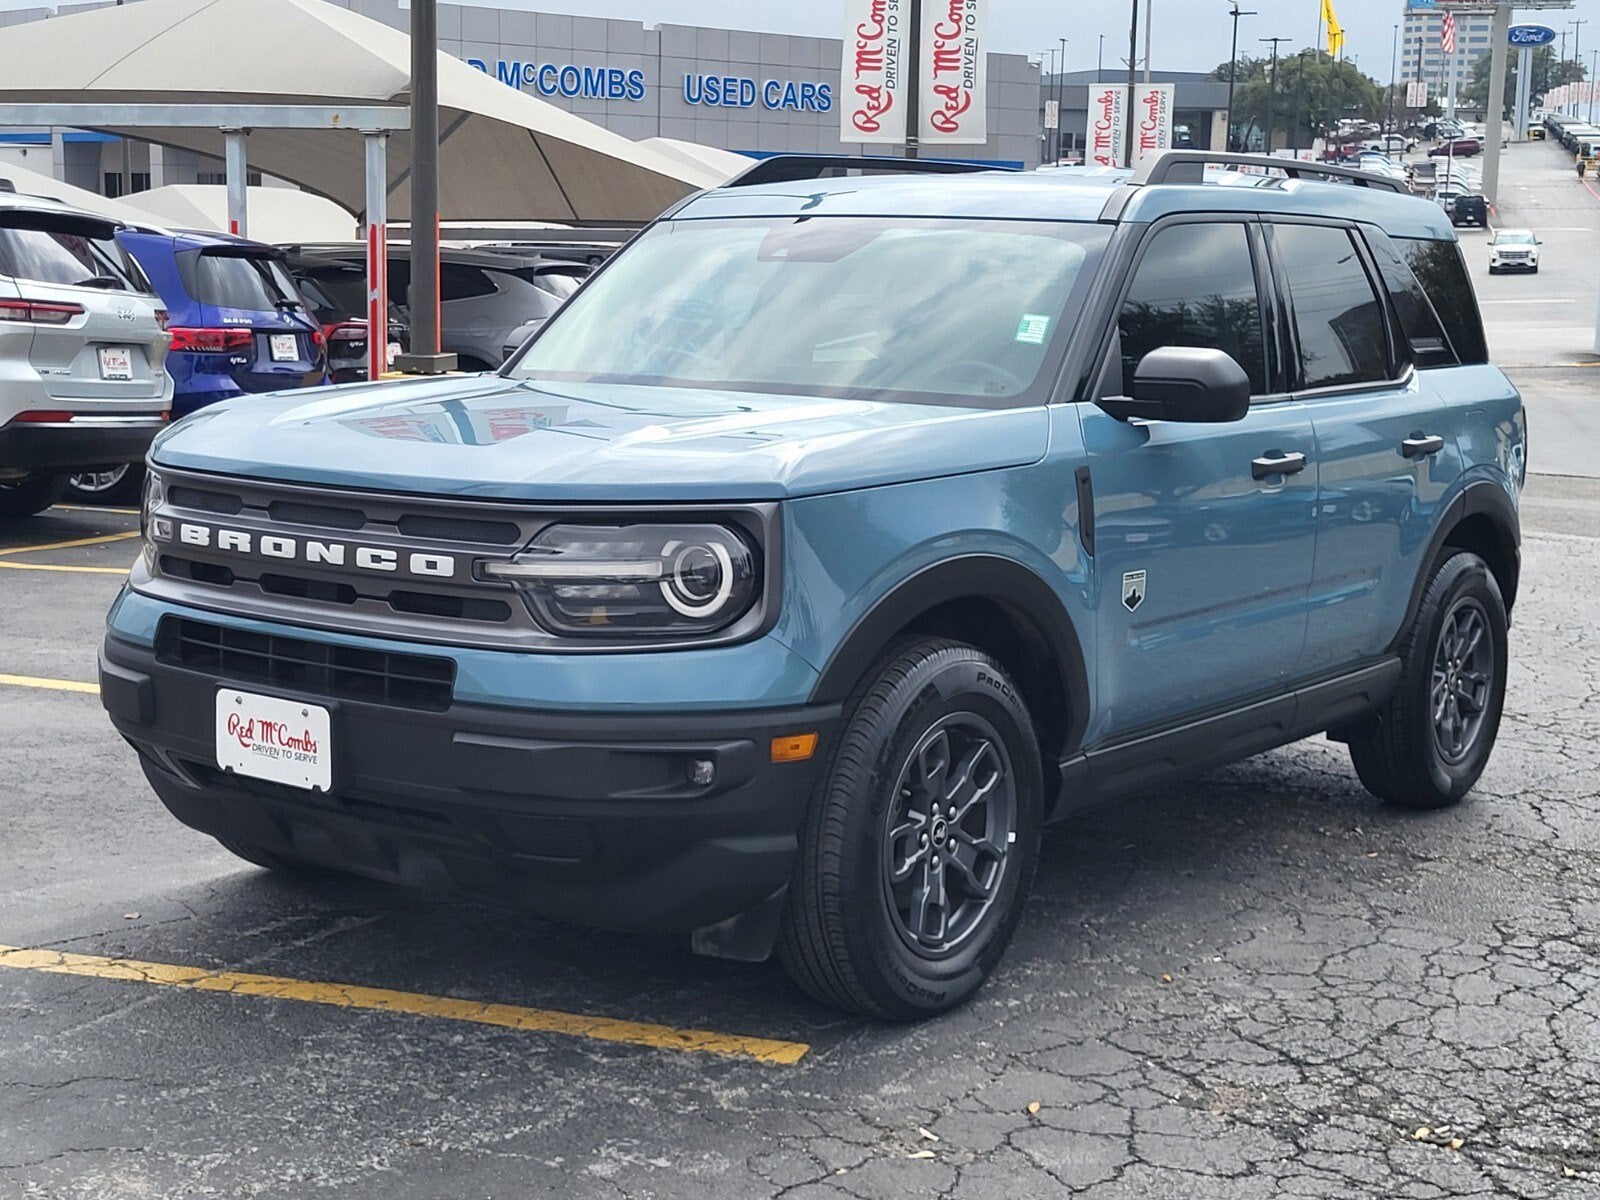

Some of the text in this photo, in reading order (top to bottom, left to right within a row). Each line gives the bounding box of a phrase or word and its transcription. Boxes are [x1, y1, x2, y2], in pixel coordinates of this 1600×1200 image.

[887, 15, 898, 34] TO
[965, 14, 976, 33] TO
[1511, 28, 1544, 42] Ford
[886, 38, 897, 90] DRIVEN
[963, 38, 975, 90] DRIVEN
[685, 74, 832, 112] USED CARS
[852, 84, 893, 133] Red
[930, 84, 971, 133] Red
[1095, 90, 1114, 153] McCombs
[1113, 116, 1120, 127] TO
[1159, 116, 1166, 127] TO
[180, 523, 454, 578] BRONCO
[228, 712, 318, 754] Red McCombs
[252, 743, 318, 765] DRIVEN TO SERVE
